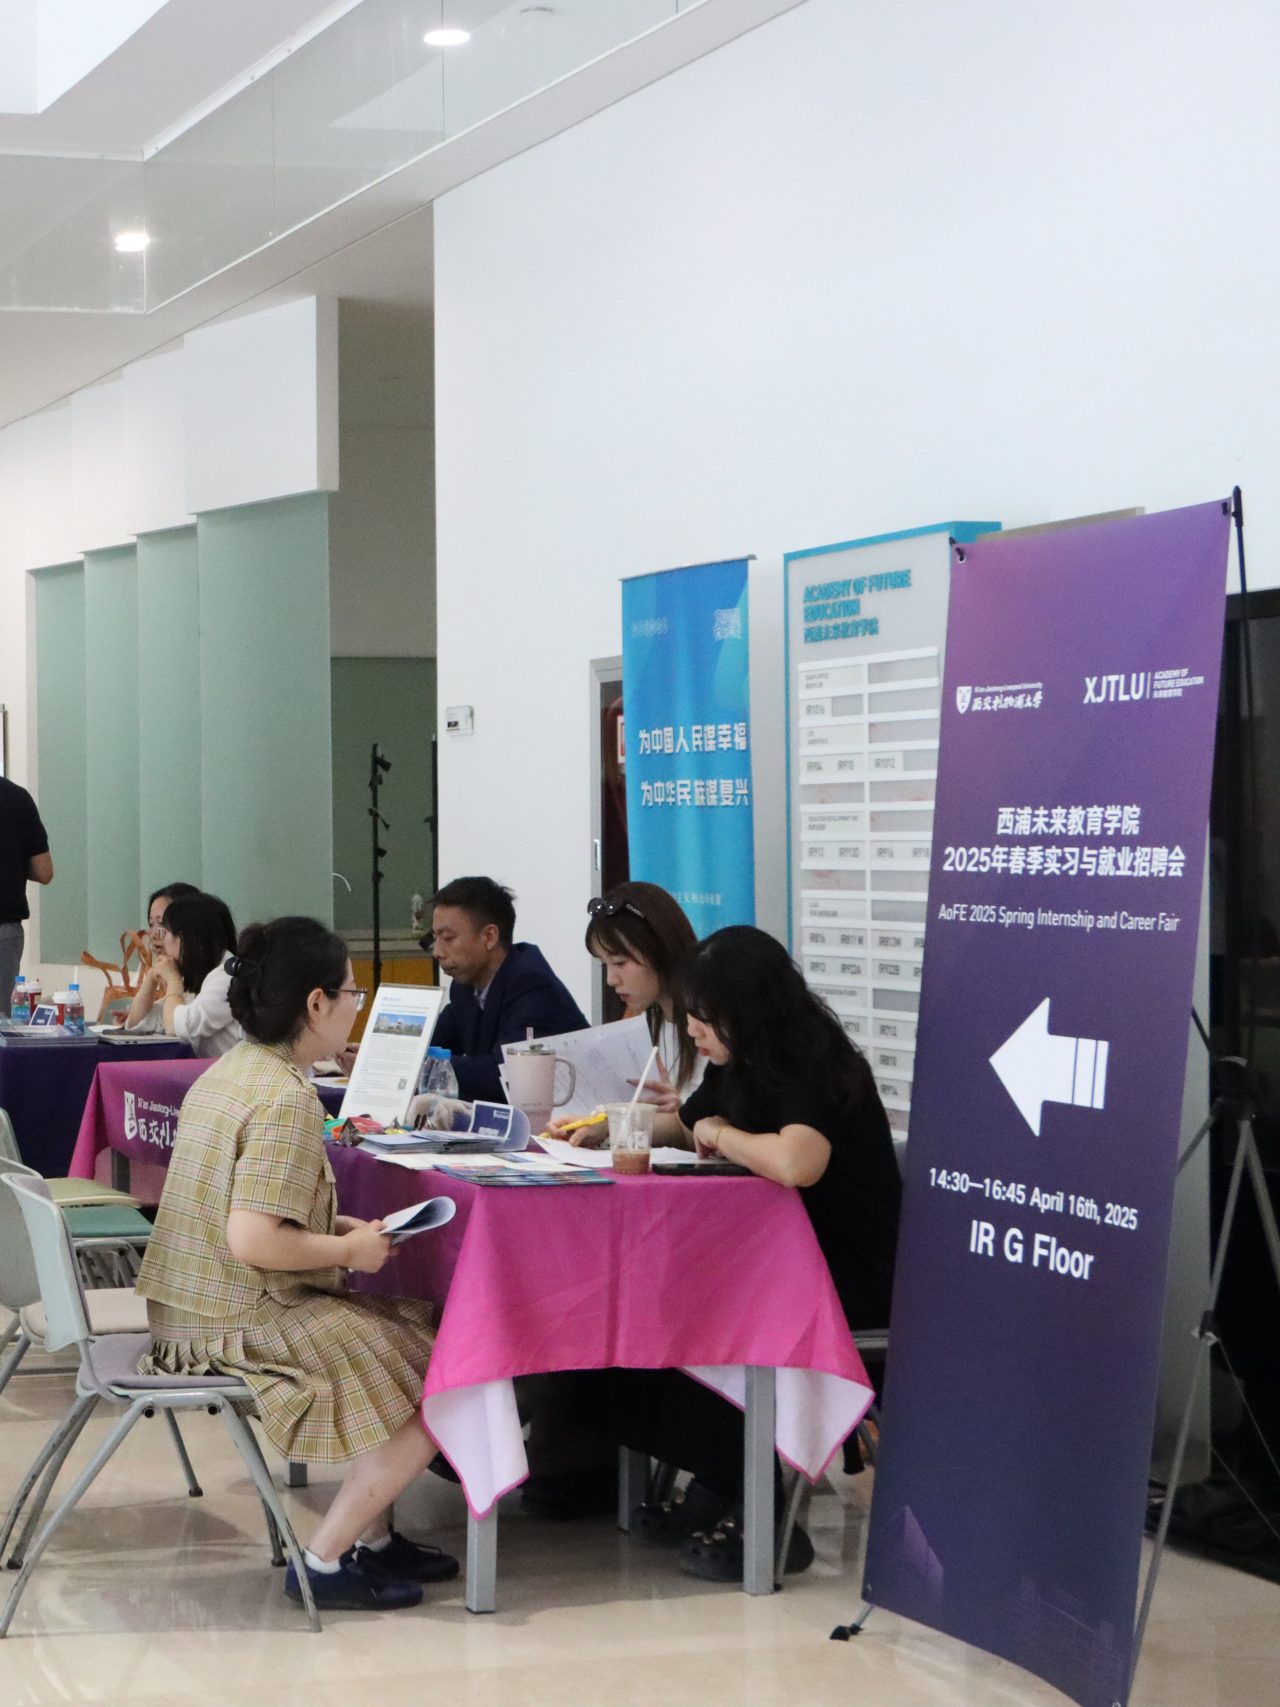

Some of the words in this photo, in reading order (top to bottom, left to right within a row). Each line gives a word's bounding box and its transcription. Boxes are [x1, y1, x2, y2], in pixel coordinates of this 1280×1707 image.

[803, 579, 852, 604] ACADEMY
[868, 569, 912, 593] FUTURE
[803, 598, 861, 623] EDUCATION
[1083, 672, 1145, 704] XJTLU
[638, 722, 747, 755] 为中国人民谋幸福
[641, 778, 749, 807] 为中华民族谋复兴
[997, 805, 1141, 836] 西浦未来教育学院
[943, 845, 1186, 877] 2025年春季实习与就业招聘会
[938, 903, 968, 921] AoFE
[969, 904, 997, 923] 2025
[998, 906, 1035, 930] Spring
[1037, 907, 1095, 932] Internship
[1096, 911, 1118, 930] and
[1120, 911, 1156, 931] Career
[1158, 912, 1181, 932] Fair
[137, 1097, 149, 1110] Xi'an
[1030, 1186, 1064, 1213] April
[1068, 1194, 1101, 1225] 16th,
[1104, 1202, 1138, 1231] 2025
[969, 1219, 995, 1257] IR
[1004, 1227, 1024, 1264] G
[1032, 1233, 1095, 1281] Floor
